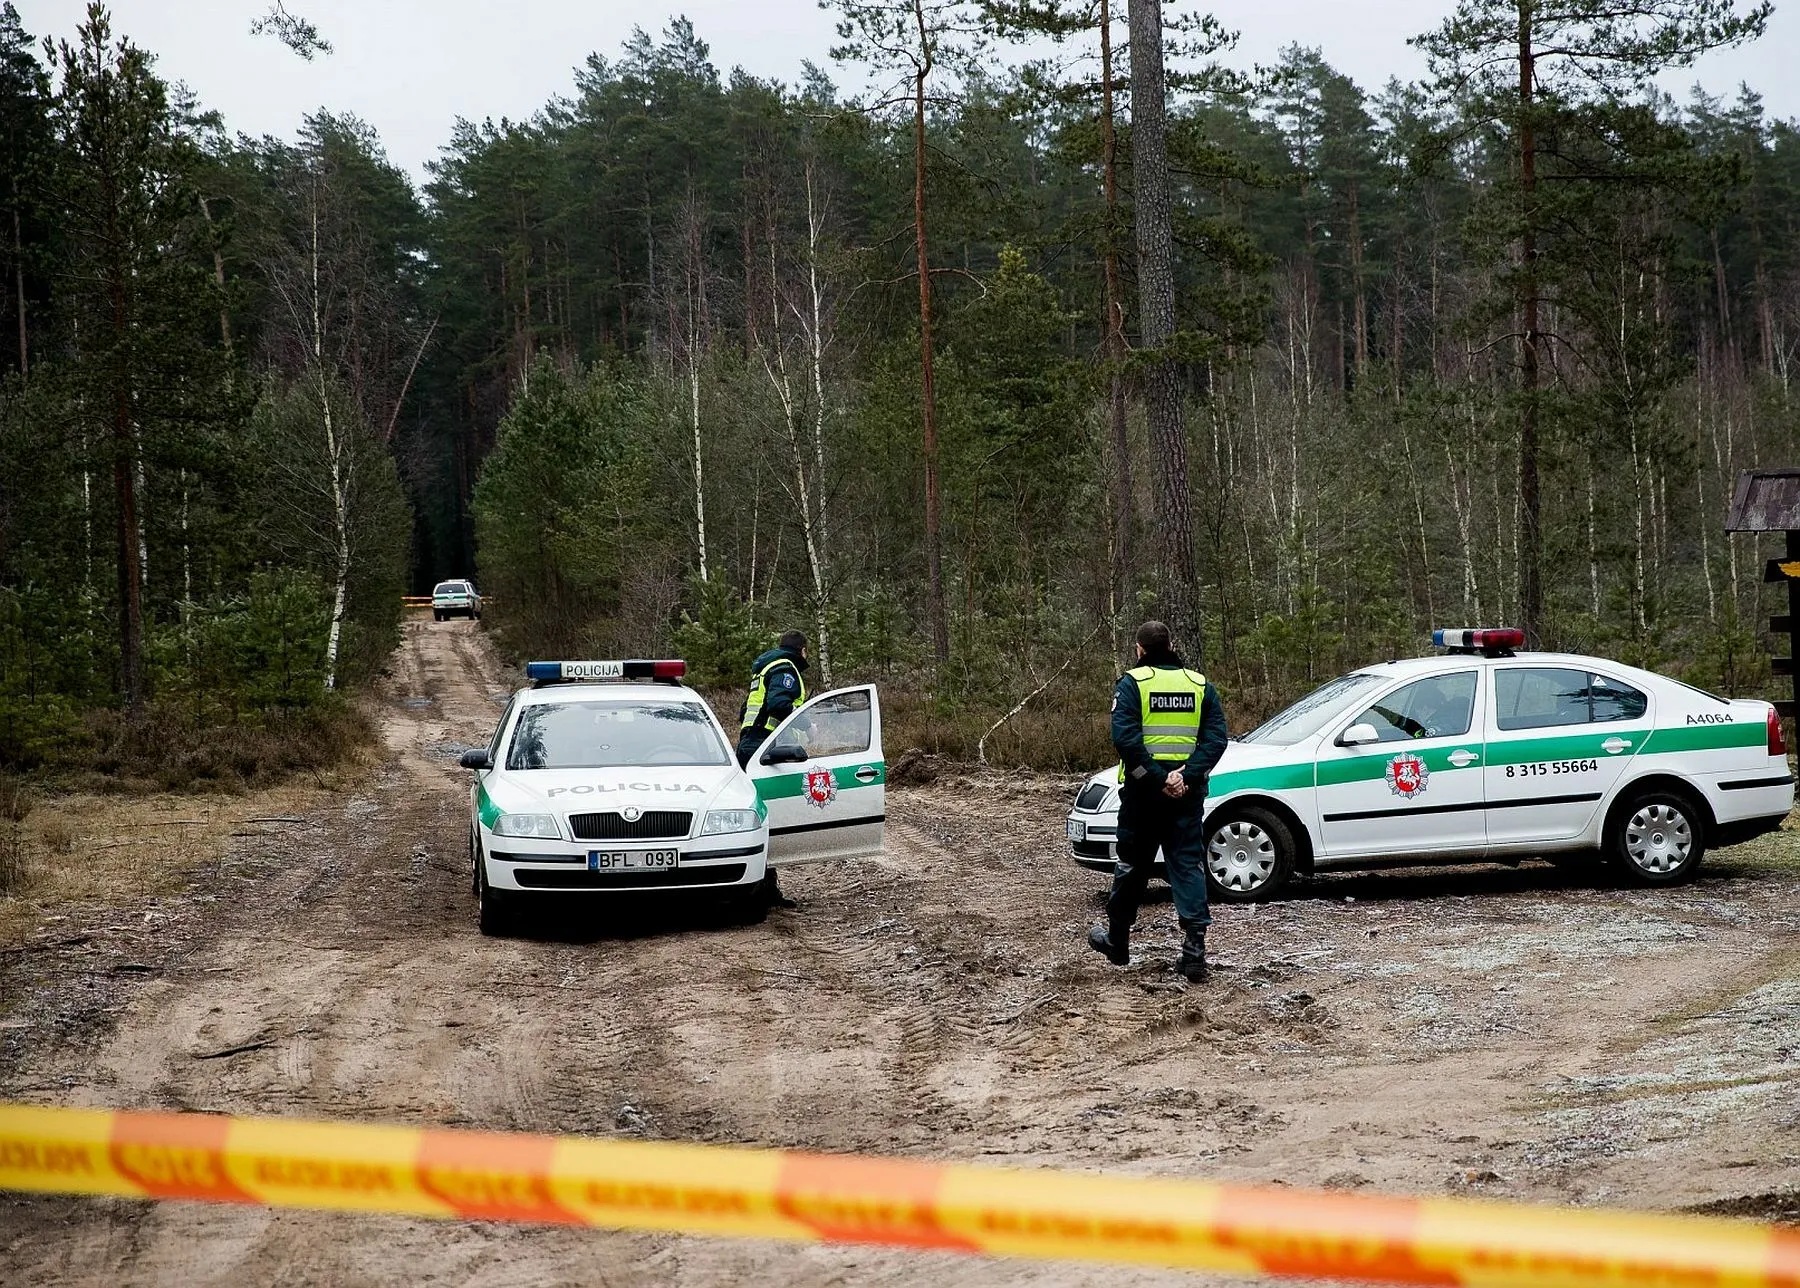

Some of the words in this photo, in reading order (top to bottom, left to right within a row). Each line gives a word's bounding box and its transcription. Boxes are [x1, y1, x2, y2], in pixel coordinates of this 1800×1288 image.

[566, 665, 620, 676] POLICIJA
[1150, 696, 1194, 708] POLICIJA
[1686, 713, 1734, 725] A4064
[1505, 766, 1515, 778] 8
[1519, 763, 1548, 777] 315
[1552, 759, 1598, 774] 55664
[547, 782, 707, 797] POLICIJA
[600, 853, 634, 867] BFL
[645, 852, 674, 866] 093
